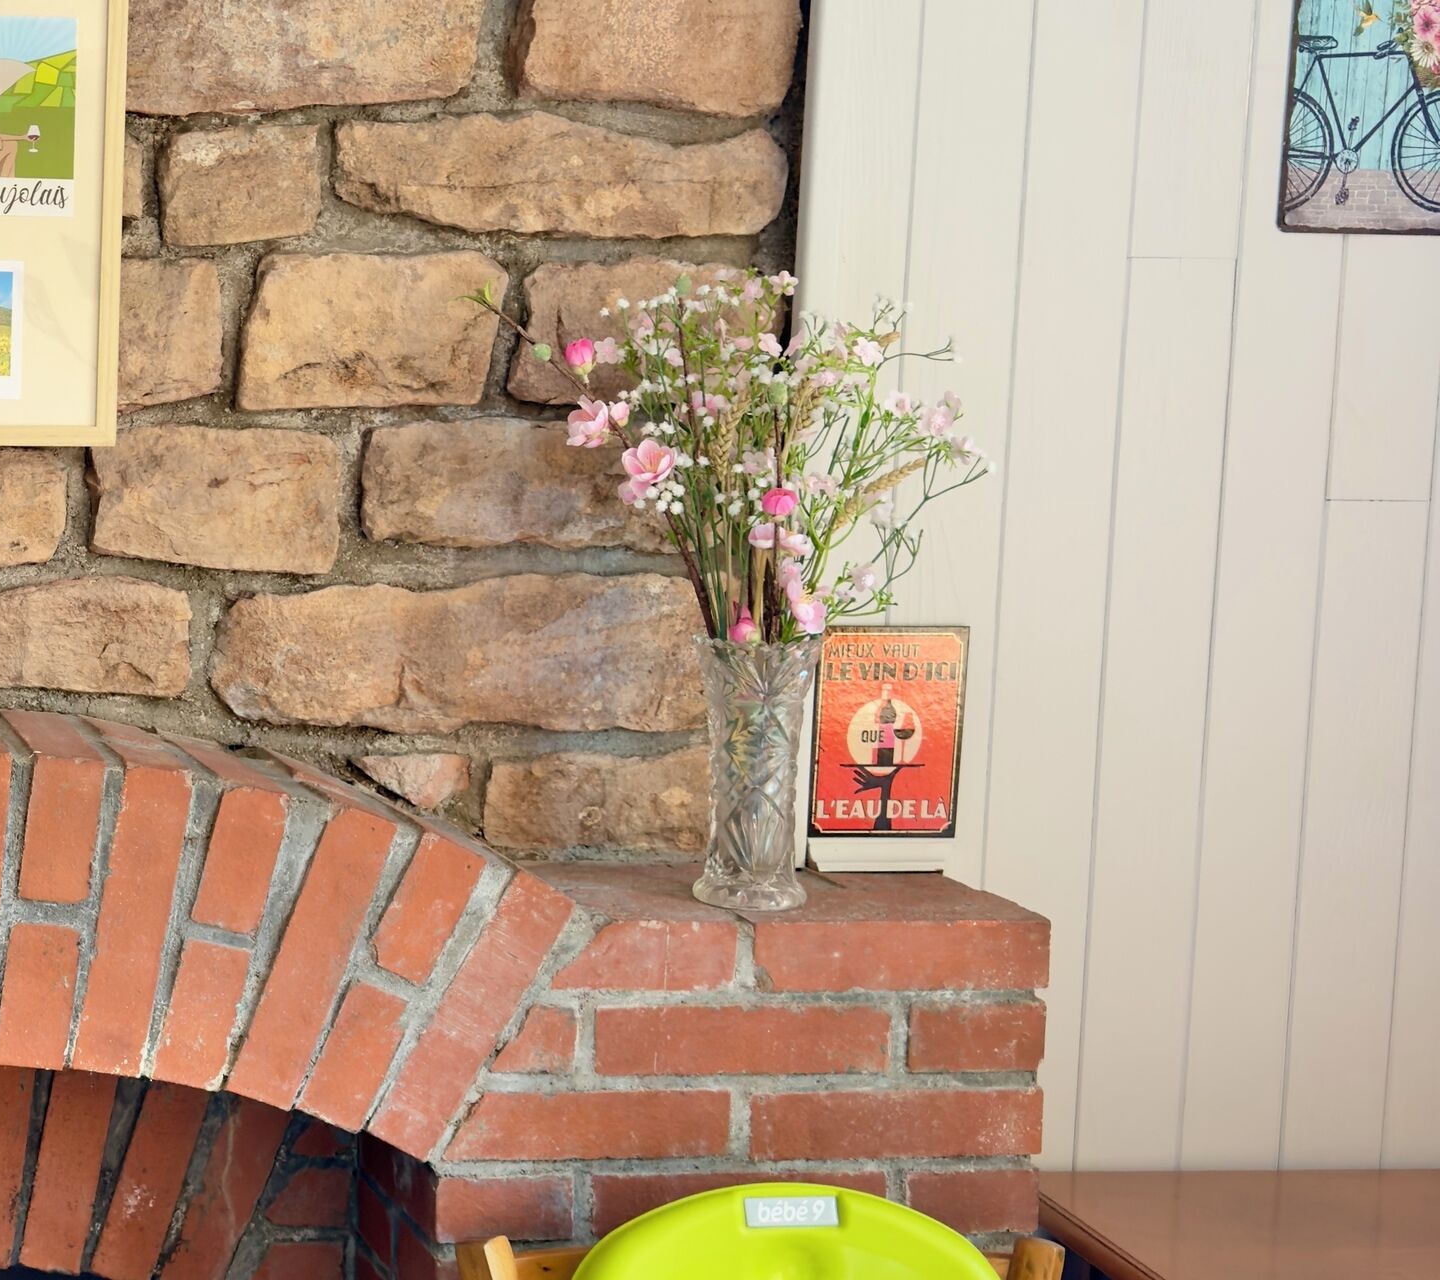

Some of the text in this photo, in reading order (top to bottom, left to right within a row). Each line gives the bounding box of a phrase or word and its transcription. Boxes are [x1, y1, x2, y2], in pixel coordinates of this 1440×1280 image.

[828, 643, 920, 658] MIEUX VAUT
[825, 661, 958, 681] LE VIN D'ICI
[861, 730, 885, 743] QUE
[816, 797, 947, 819] L'EAU DE LÀ
[758, 1199, 826, 1223] bébé 9
